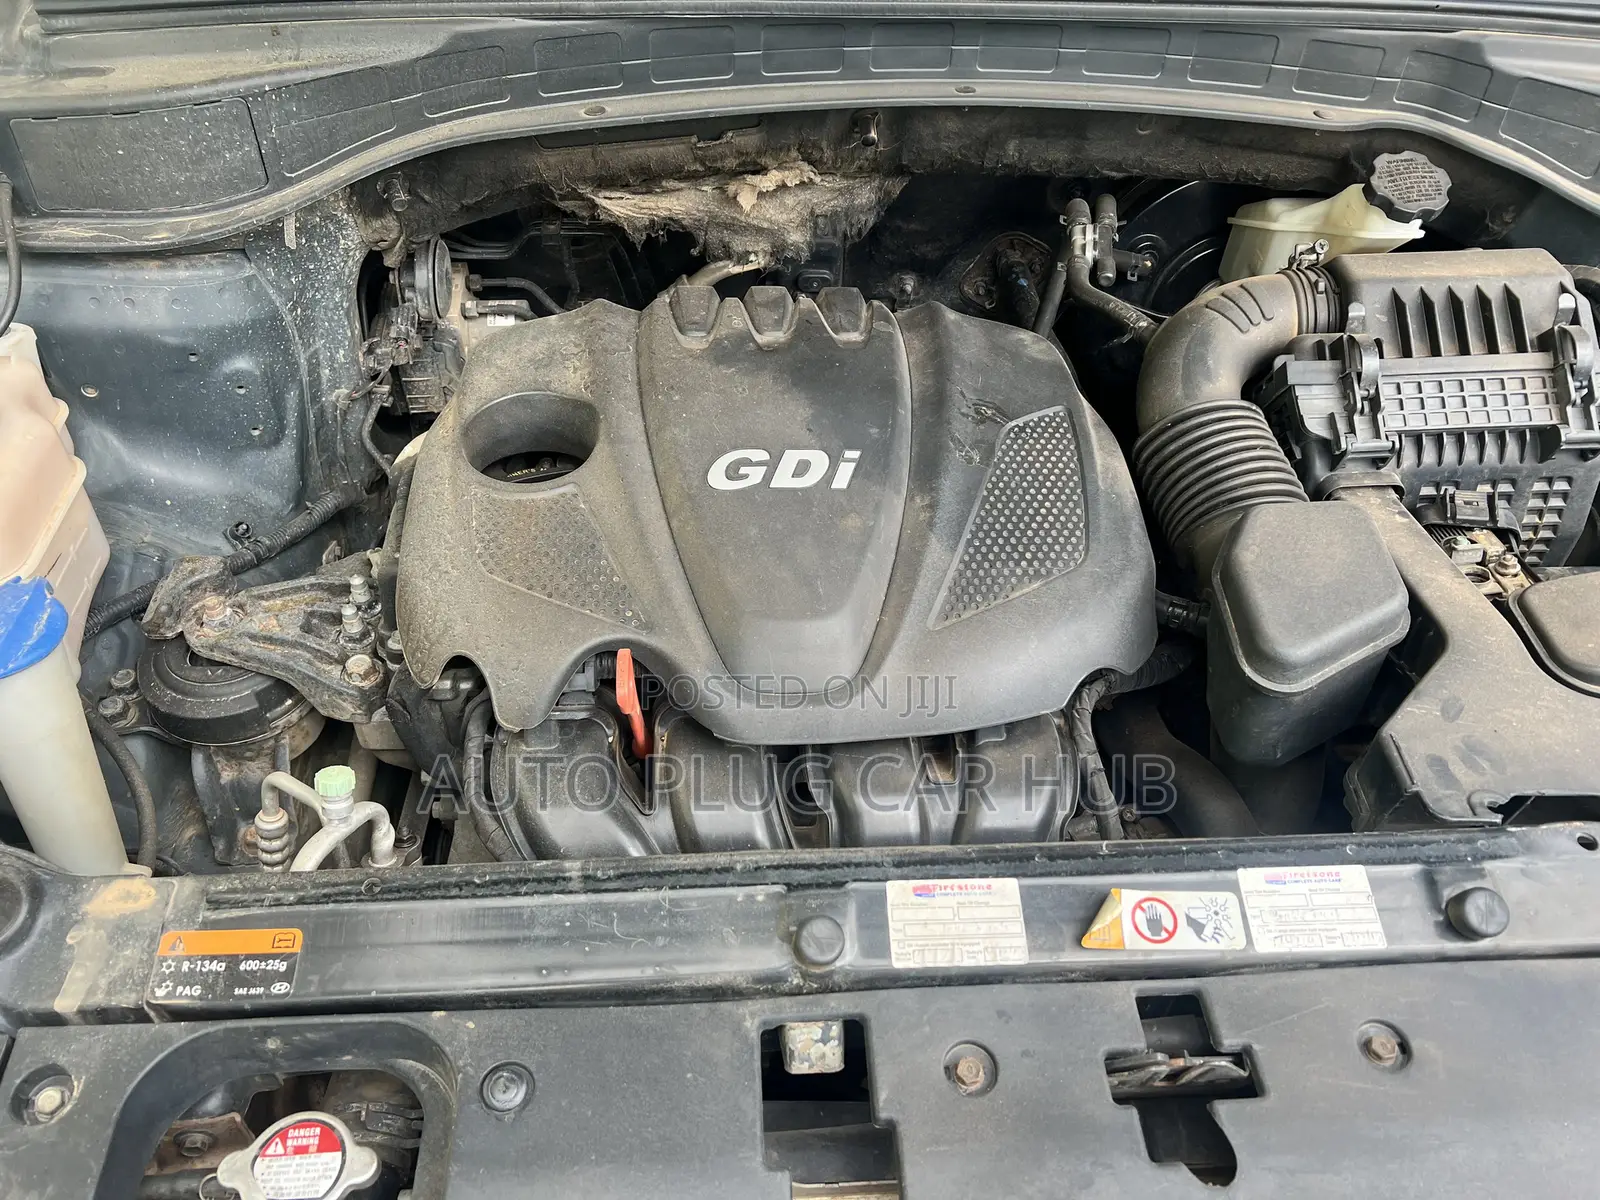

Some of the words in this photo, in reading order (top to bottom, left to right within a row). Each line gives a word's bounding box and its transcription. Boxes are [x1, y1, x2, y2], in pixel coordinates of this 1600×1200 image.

[706, 448, 863, 491] GDi
[181, 959, 226, 972] R-134a
[239, 959, 288, 972] 600±25g
[175, 984, 201, 996] PAG
[287, 1127, 321, 1138] DANGER
[286, 1136, 320, 1147] WARNING
